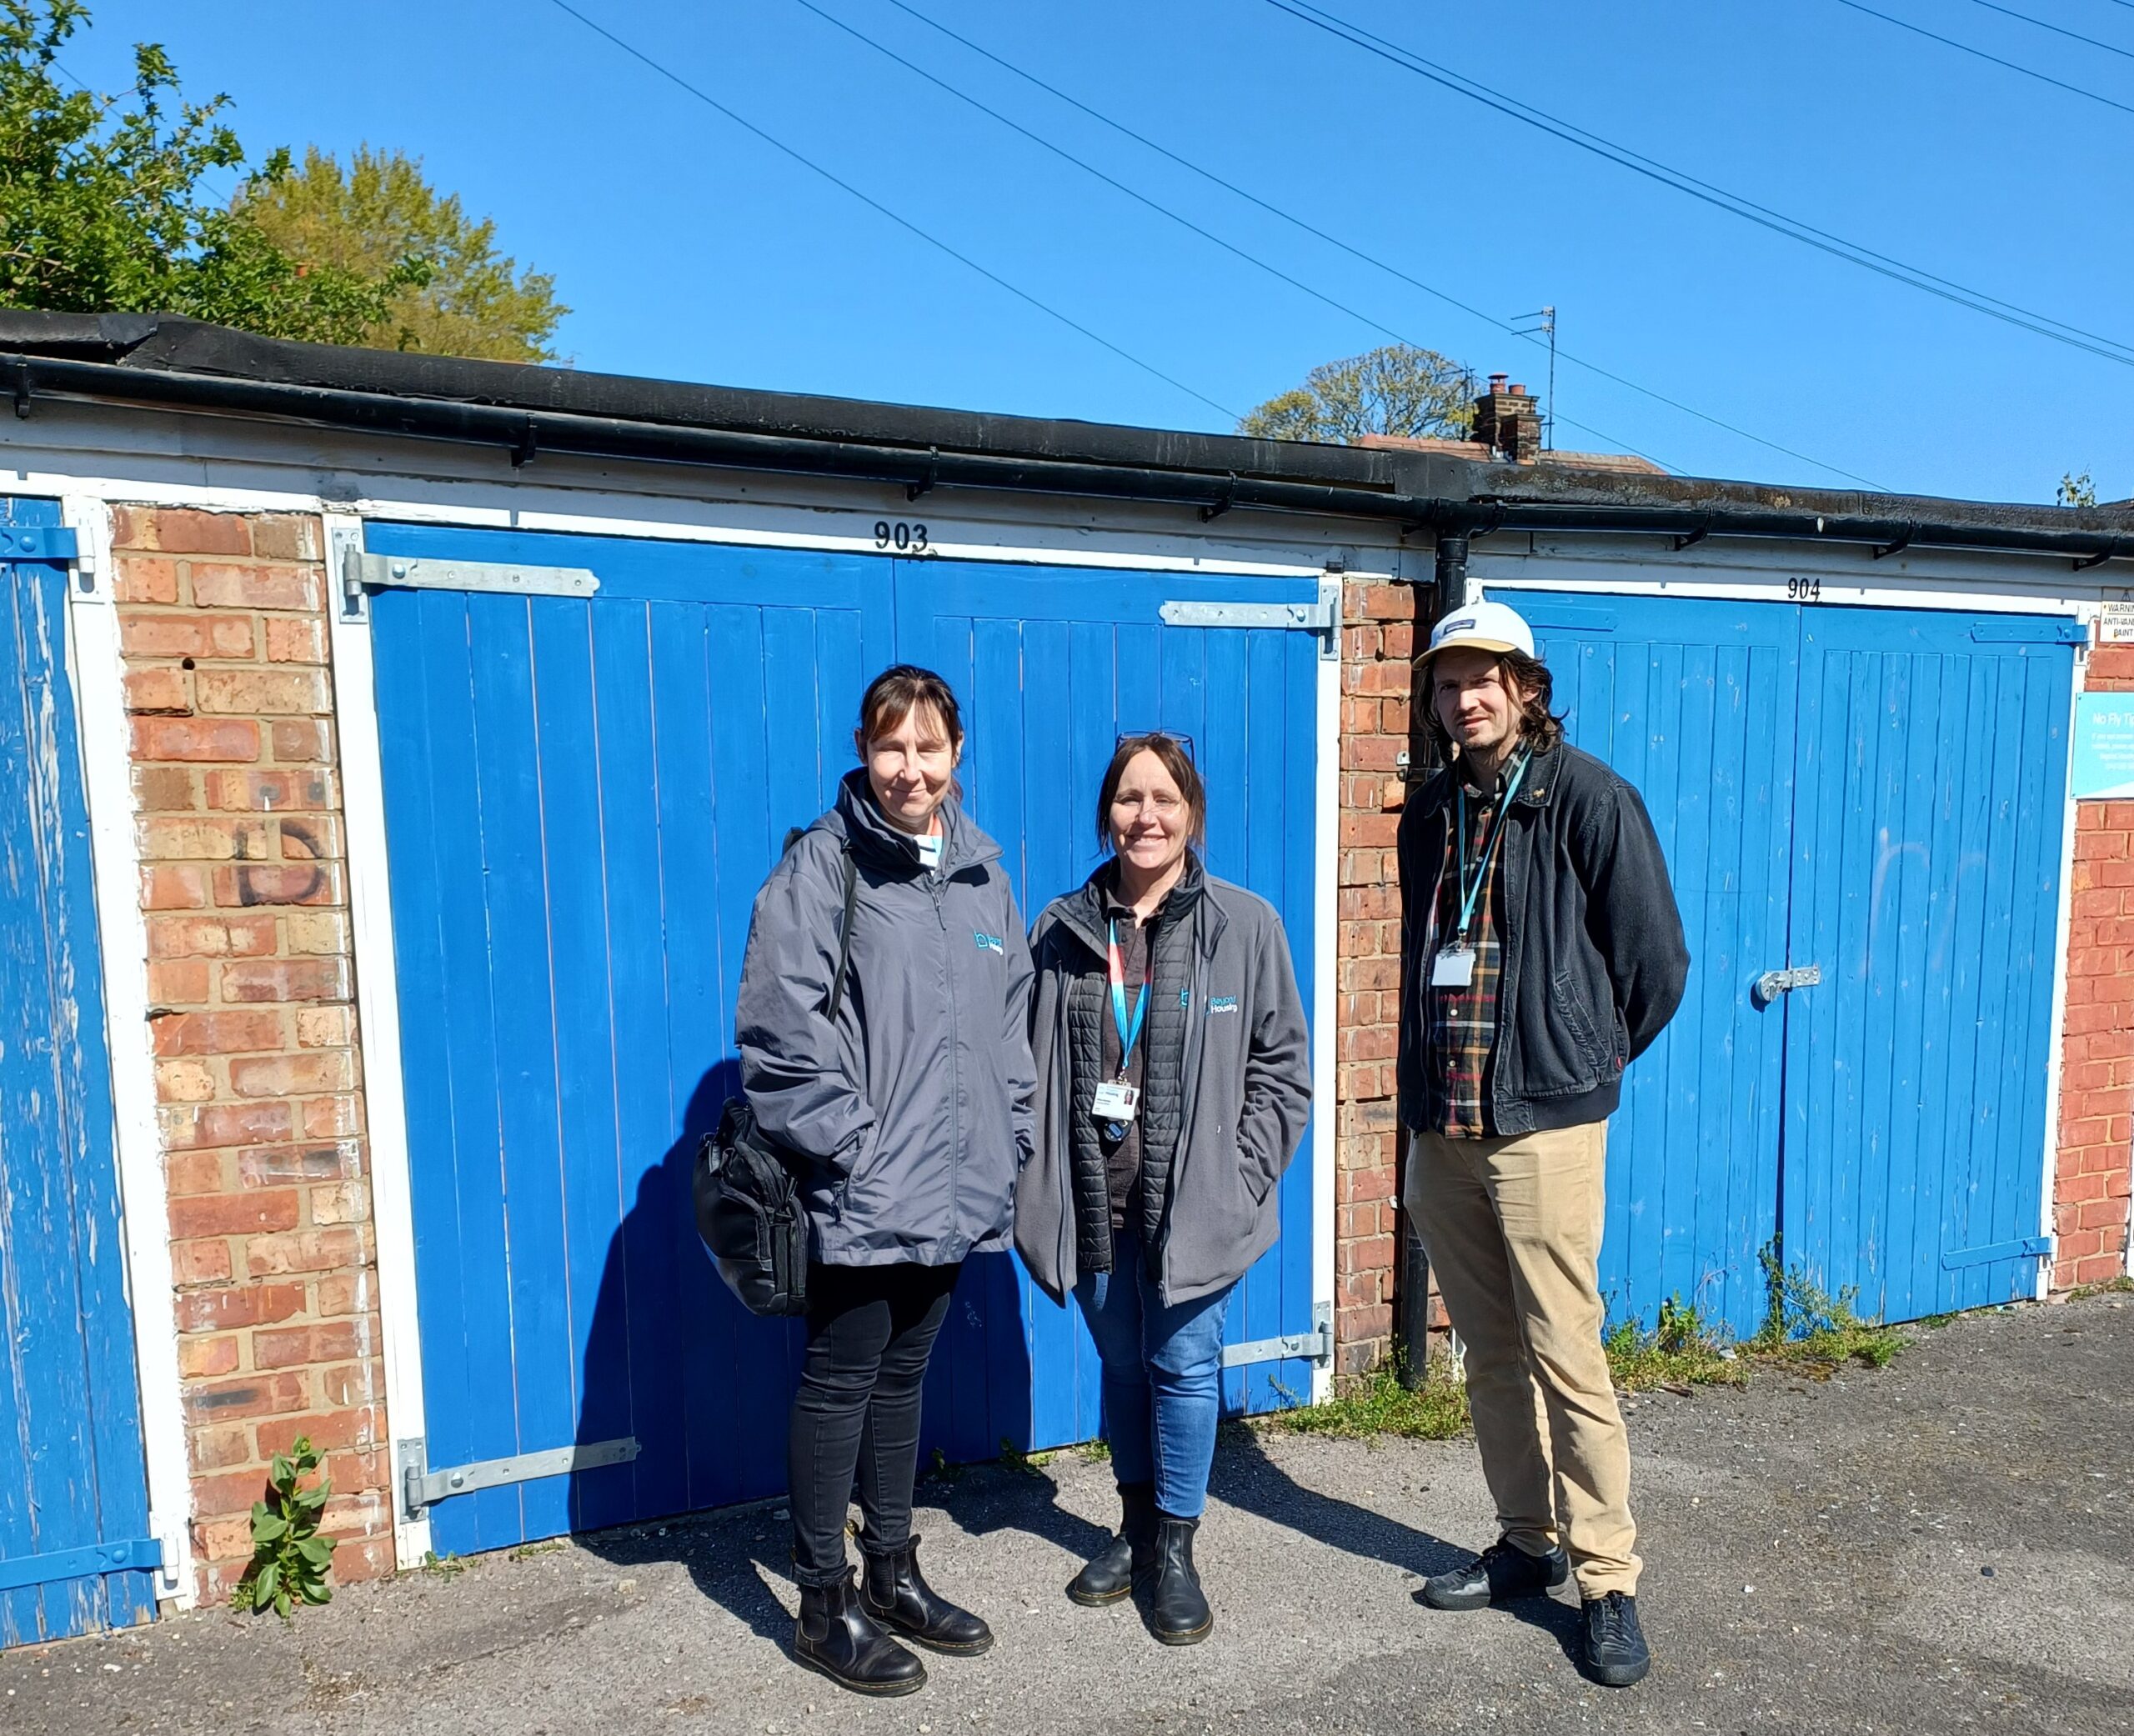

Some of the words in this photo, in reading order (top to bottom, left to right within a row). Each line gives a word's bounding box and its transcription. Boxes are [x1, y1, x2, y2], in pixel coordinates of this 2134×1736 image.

[874, 521, 928, 553] 903
[1788, 577, 1821, 602] 904
[2103, 617, 2134, 626] ANTI-VAN
[2114, 628, 2134, 638] PAINT
[2093, 713, 2106, 724] No
[2108, 713, 2121, 727] Fly
[1210, 1003, 1238, 1014] Housing
